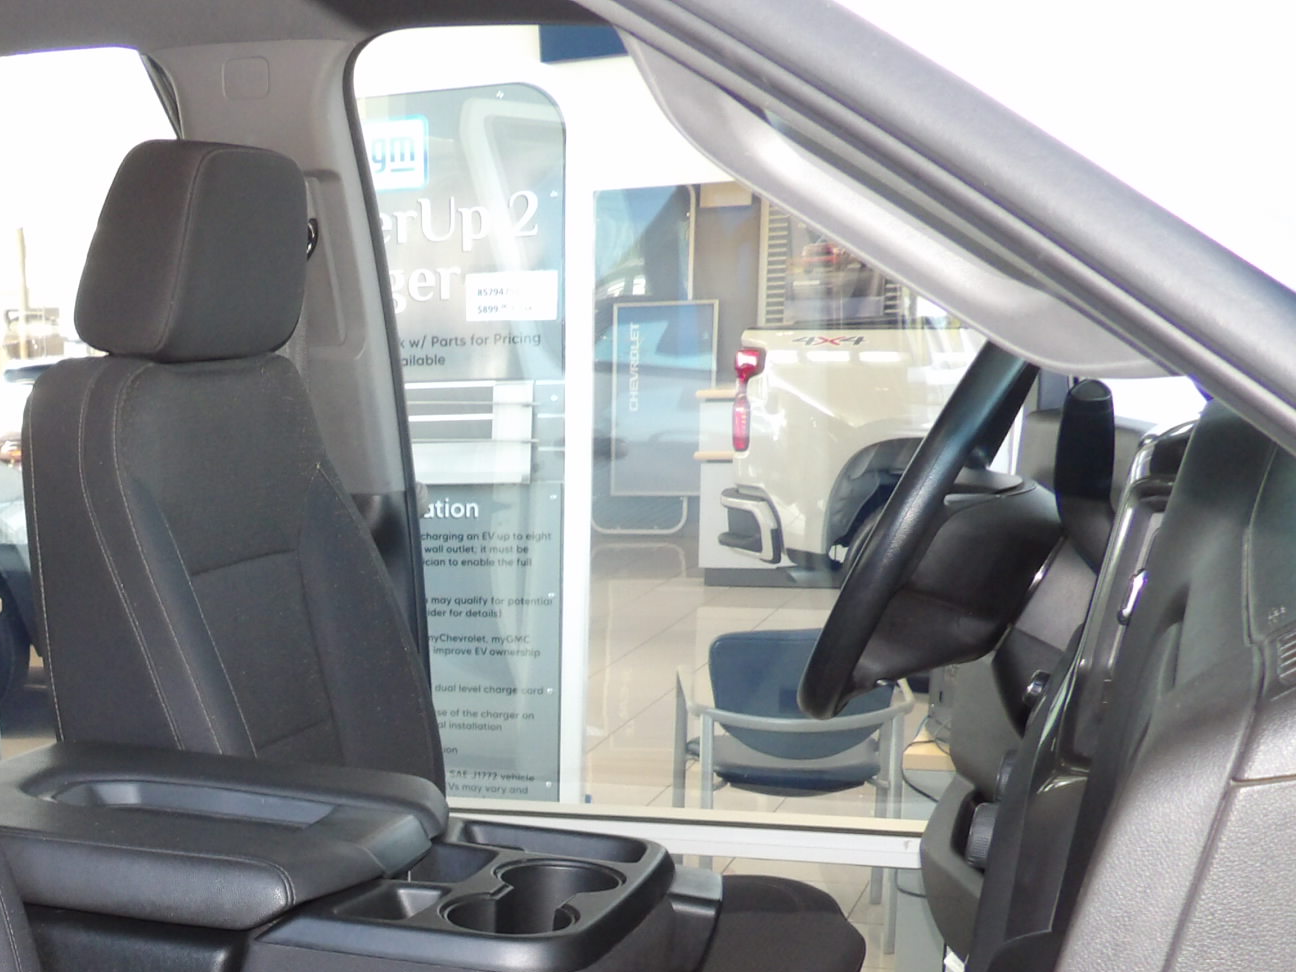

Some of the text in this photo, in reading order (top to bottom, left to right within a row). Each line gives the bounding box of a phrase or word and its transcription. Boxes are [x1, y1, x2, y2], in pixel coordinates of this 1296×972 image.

[372, 137, 415, 173] gm
[508, 190, 539, 238] 2
[409, 335, 426, 349] w/
[431, 335, 466, 348] Parts
[470, 334, 489, 346] for
[493, 332, 541, 346] Pricing
[628, 322, 641, 412] CHEVROLET
[421, 531, 552, 543] charging an EV up to eight
[424, 545, 444, 554] wall
[480, 545, 487, 553] it
[489, 546, 514, 554] must
[516, 545, 529, 554] be
[448, 558, 459, 567] to
[461, 558, 495, 567] enable
[497, 558, 514, 567] the
[516, 558, 532, 567] full
[431, 597, 452, 606] may
[454, 596, 488, 606] qualify
[490, 596, 505, 605] for
[507, 596, 553, 606] potential
[449, 609, 463, 618] for
[433, 647, 541, 657] improve EV ownership
[434, 684, 456, 692] dual
[458, 684, 481, 693] level
[483, 684, 518, 696] charge
[450, 709, 460, 717] of
[462, 709, 479, 718] the
[480, 710, 519, 720] charger
[522, 712, 535, 720] on
[449, 722, 503, 731] installation
[500, 773, 536, 782] vehicle
[461, 784, 482, 793] may
[485, 785, 508, 795] vary
[509, 786, 529, 795] and
